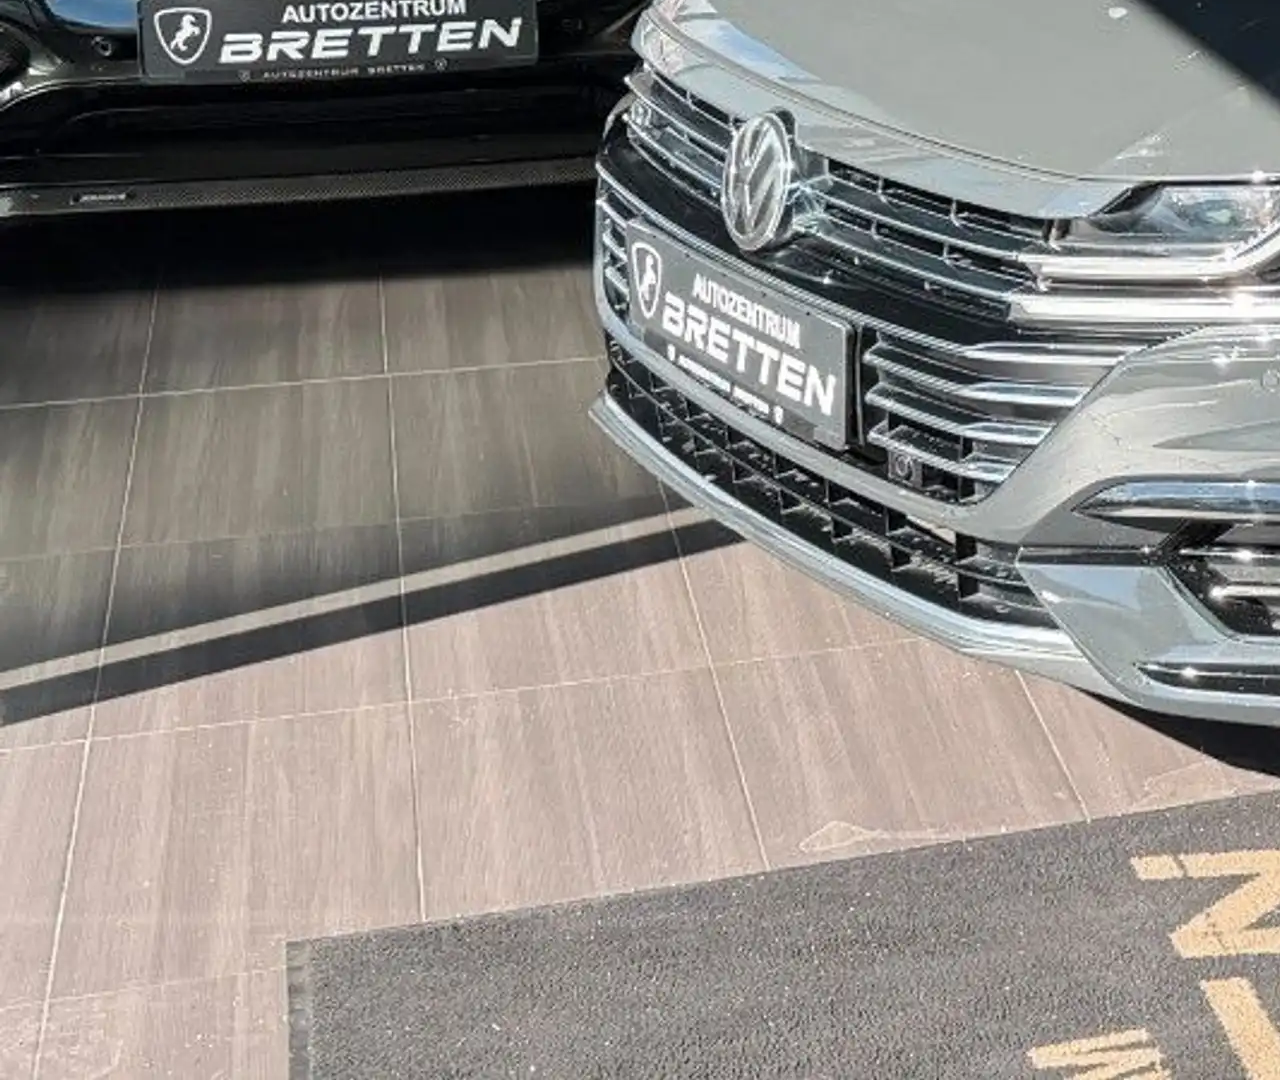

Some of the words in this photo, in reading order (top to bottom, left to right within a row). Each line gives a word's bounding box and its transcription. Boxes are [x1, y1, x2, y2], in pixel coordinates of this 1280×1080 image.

[218, 17, 522, 64] BRETTEN
[692, 273, 800, 349] AUTOZENTRUM
[661, 290, 837, 417] BRETTEN
